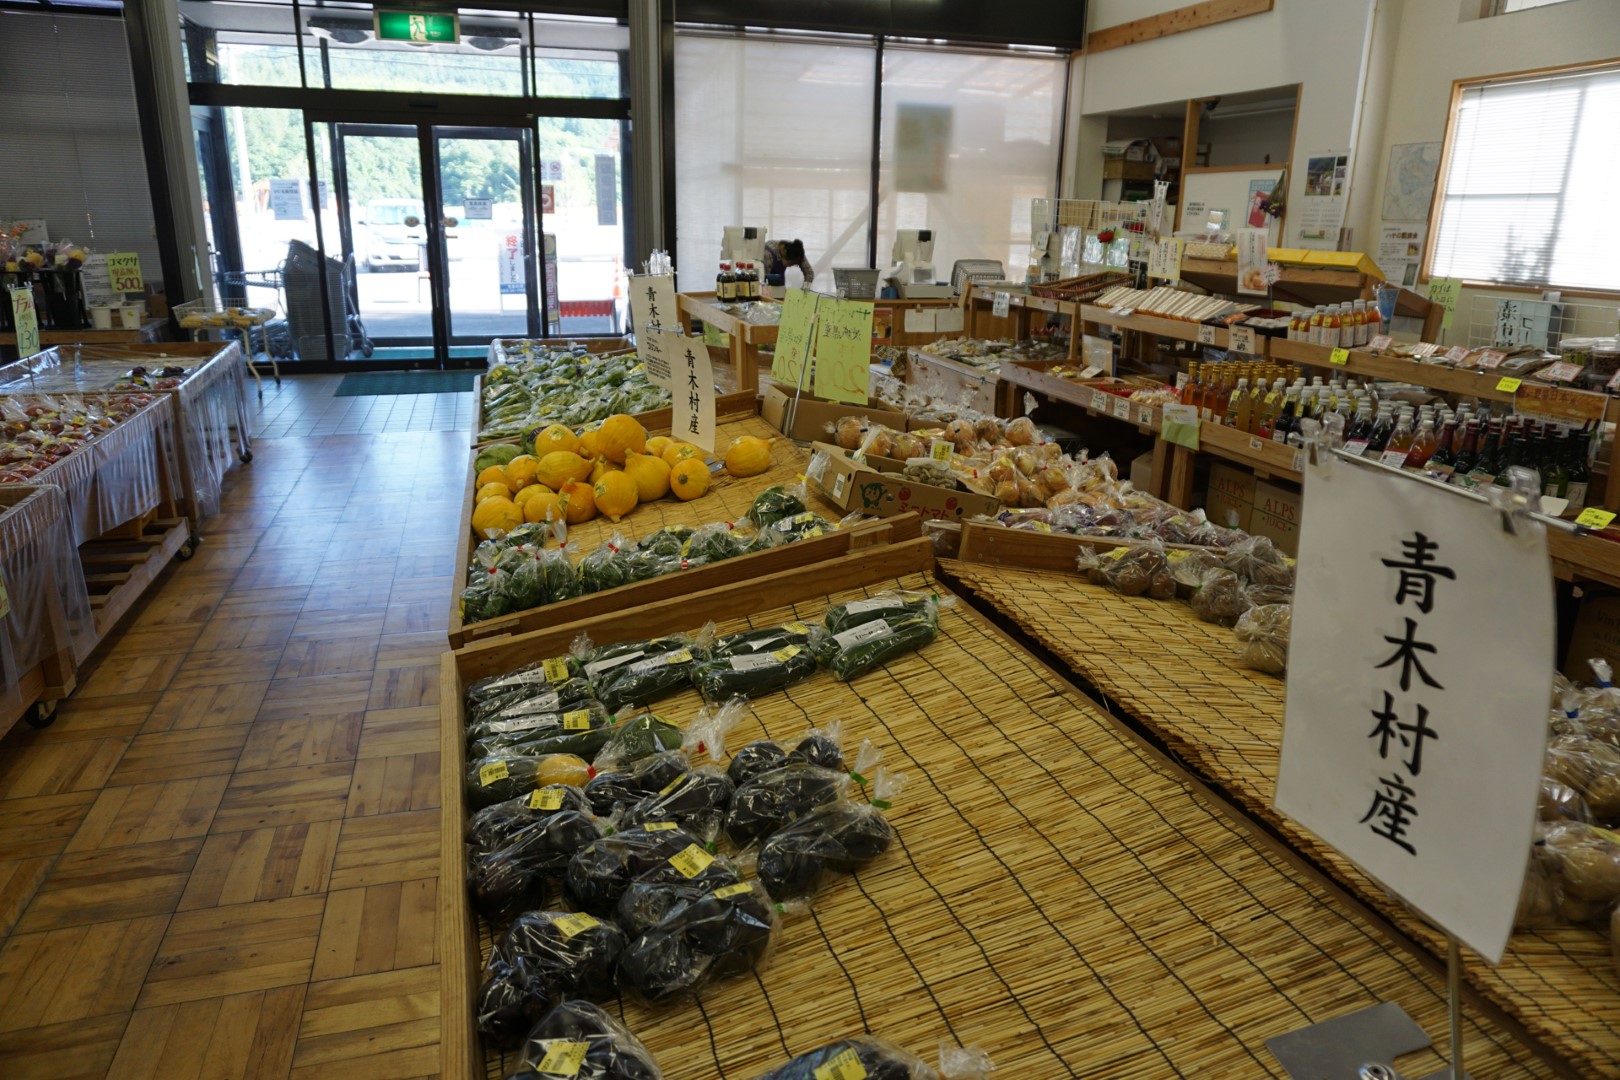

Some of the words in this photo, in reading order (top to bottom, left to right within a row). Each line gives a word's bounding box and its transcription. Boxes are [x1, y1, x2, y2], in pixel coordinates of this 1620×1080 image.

[684, 348, 702, 436] 青木村産
[1218, 477, 1246, 498] ALPS
[1263, 497, 1296, 521] ALPS
[1359, 531, 1457, 857] 青木村産
